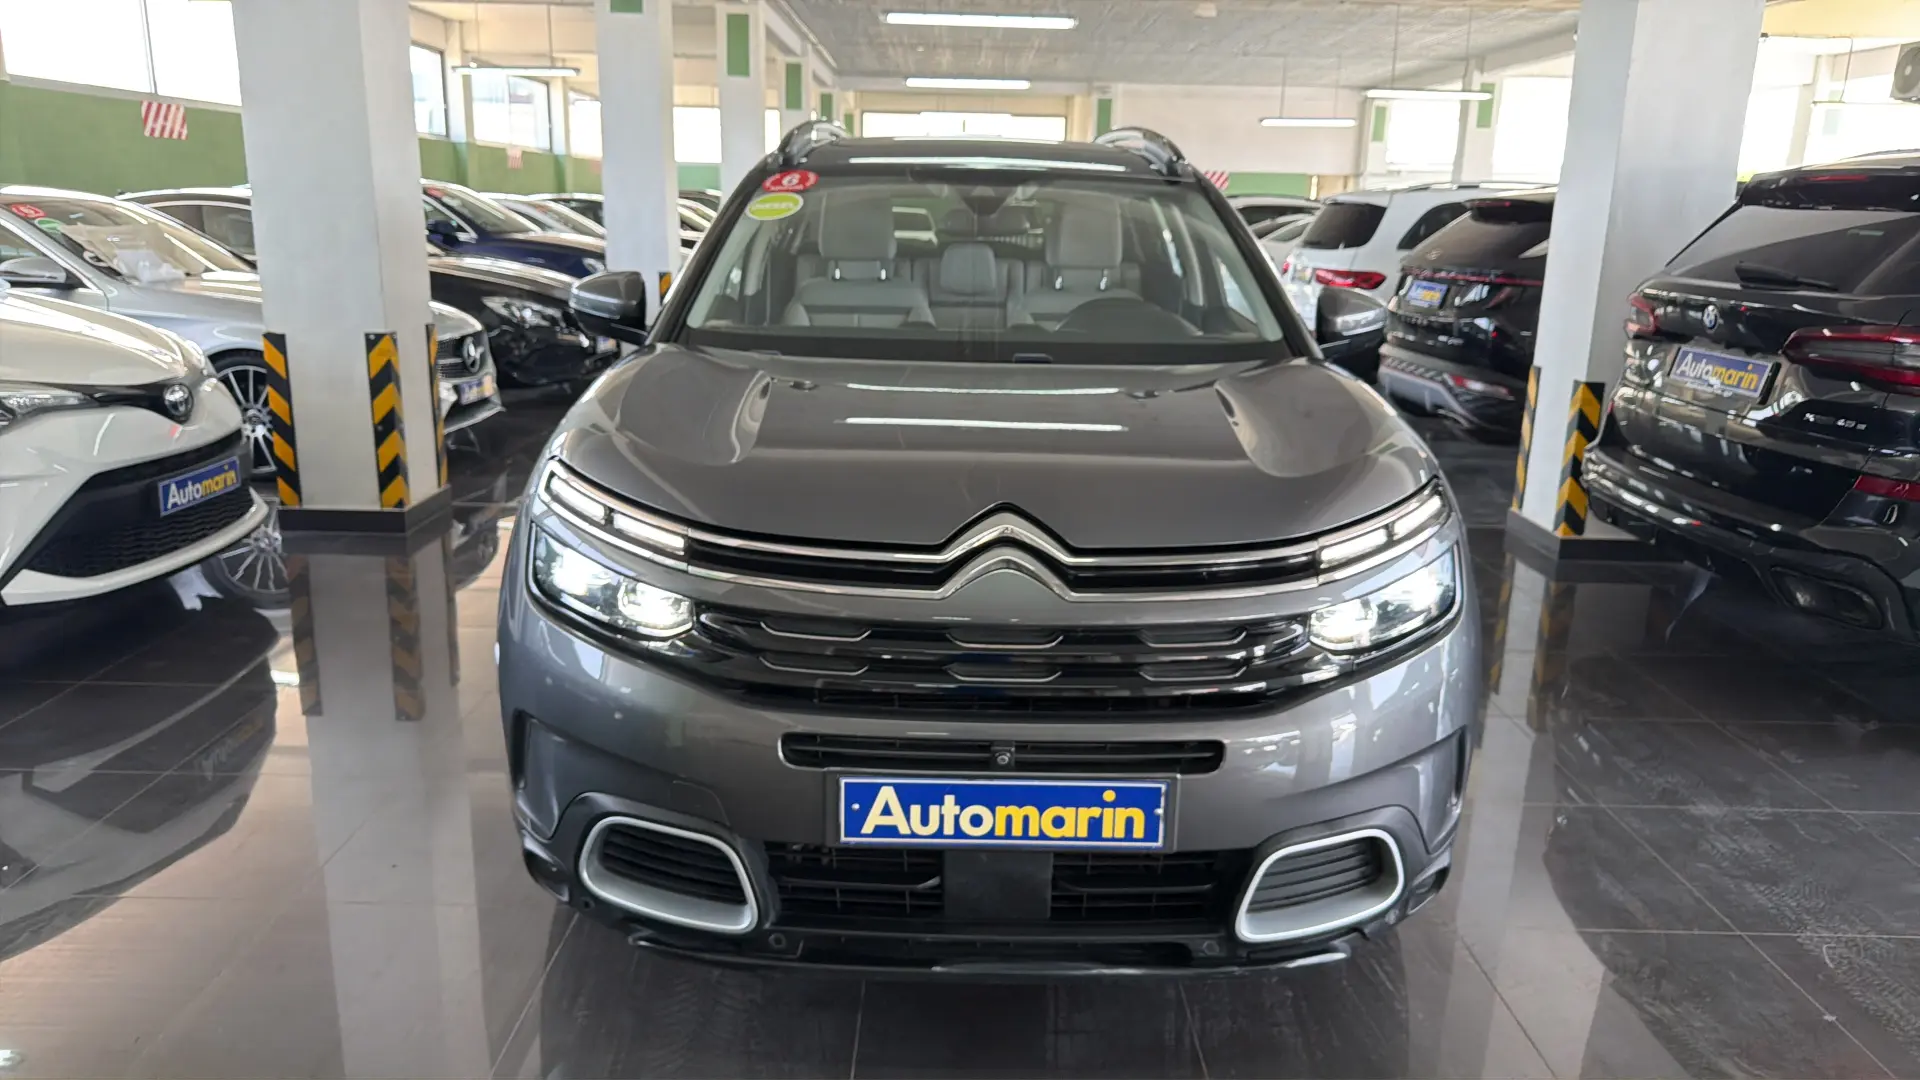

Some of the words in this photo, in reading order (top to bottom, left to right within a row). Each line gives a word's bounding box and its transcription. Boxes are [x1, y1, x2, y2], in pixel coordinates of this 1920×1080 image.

[1676, 352, 1759, 390] Automarin
[167, 464, 237, 509] Automarin
[860, 786, 1145, 838] Automarin
